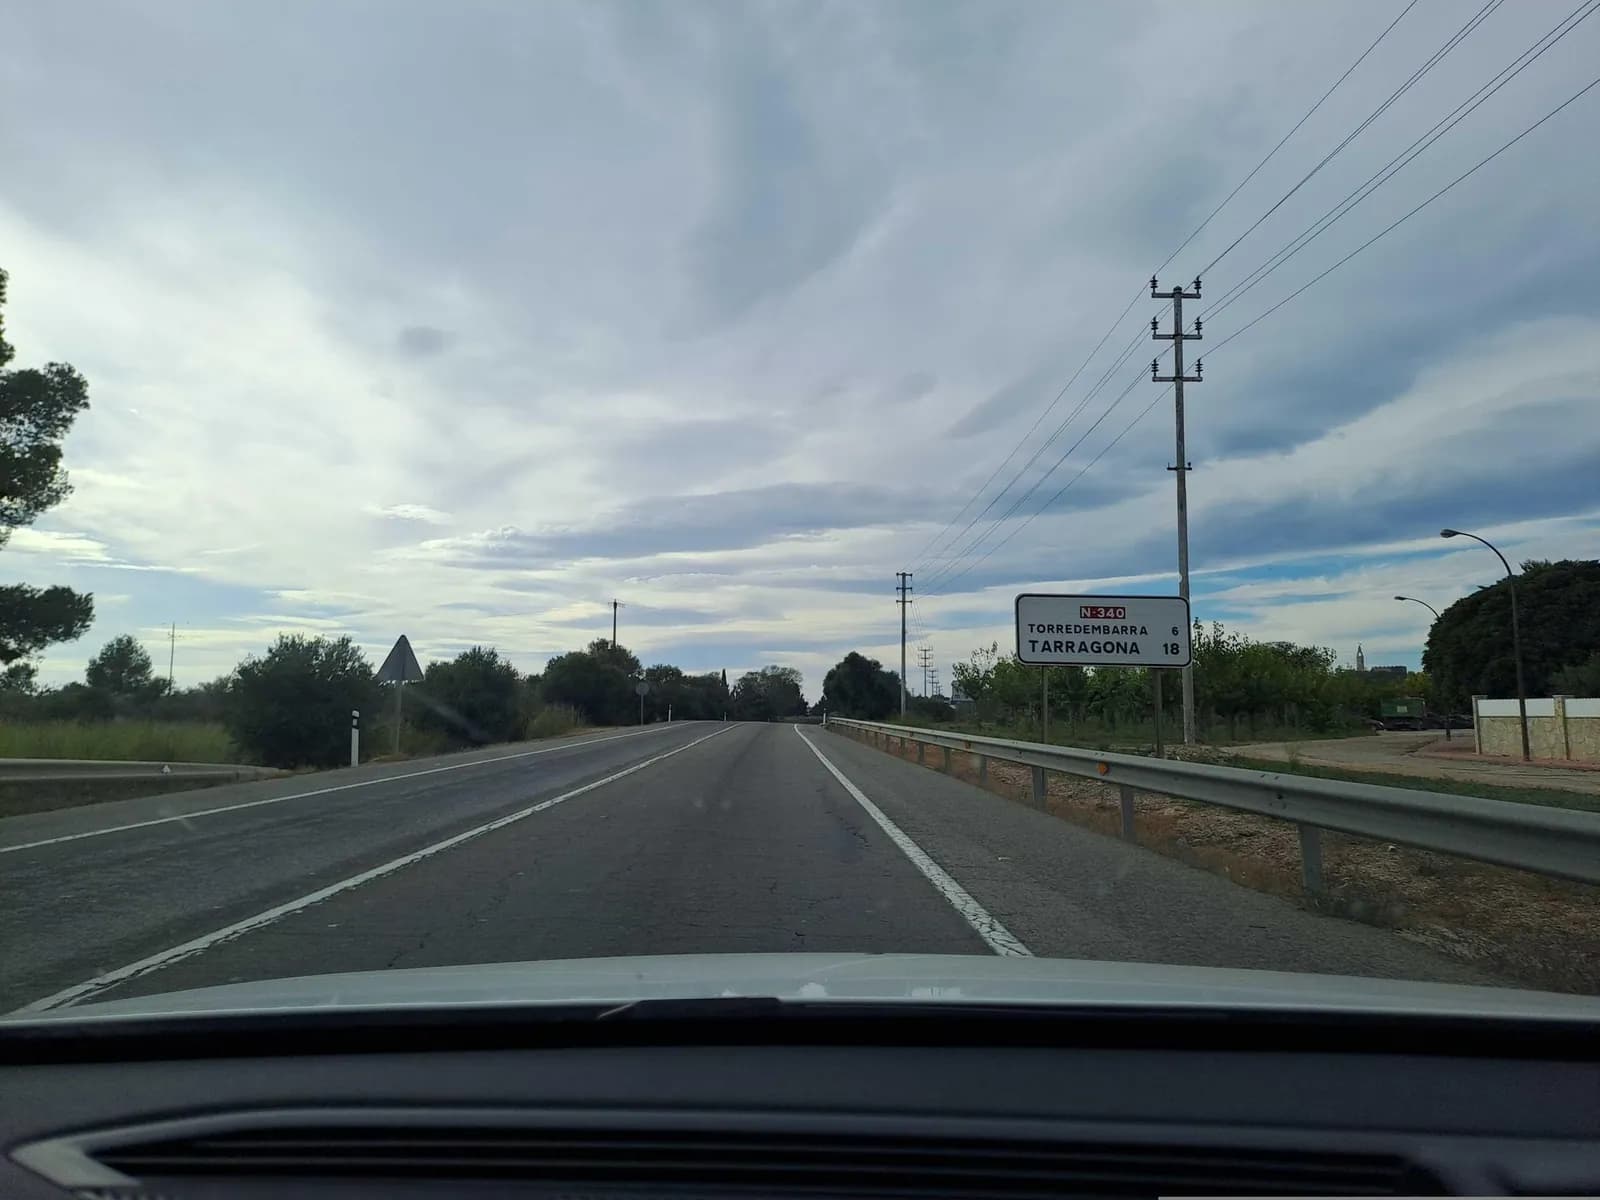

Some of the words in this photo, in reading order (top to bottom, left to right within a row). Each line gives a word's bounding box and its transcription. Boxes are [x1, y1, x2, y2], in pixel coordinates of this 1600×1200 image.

[1081, 607, 1125, 618] N-340
[1028, 624, 1148, 636] TORREDEMBARRA
[1171, 626, 1179, 636] 6
[1029, 640, 1140, 655] TARRAGONA
[1163, 643, 1180, 655] 18
